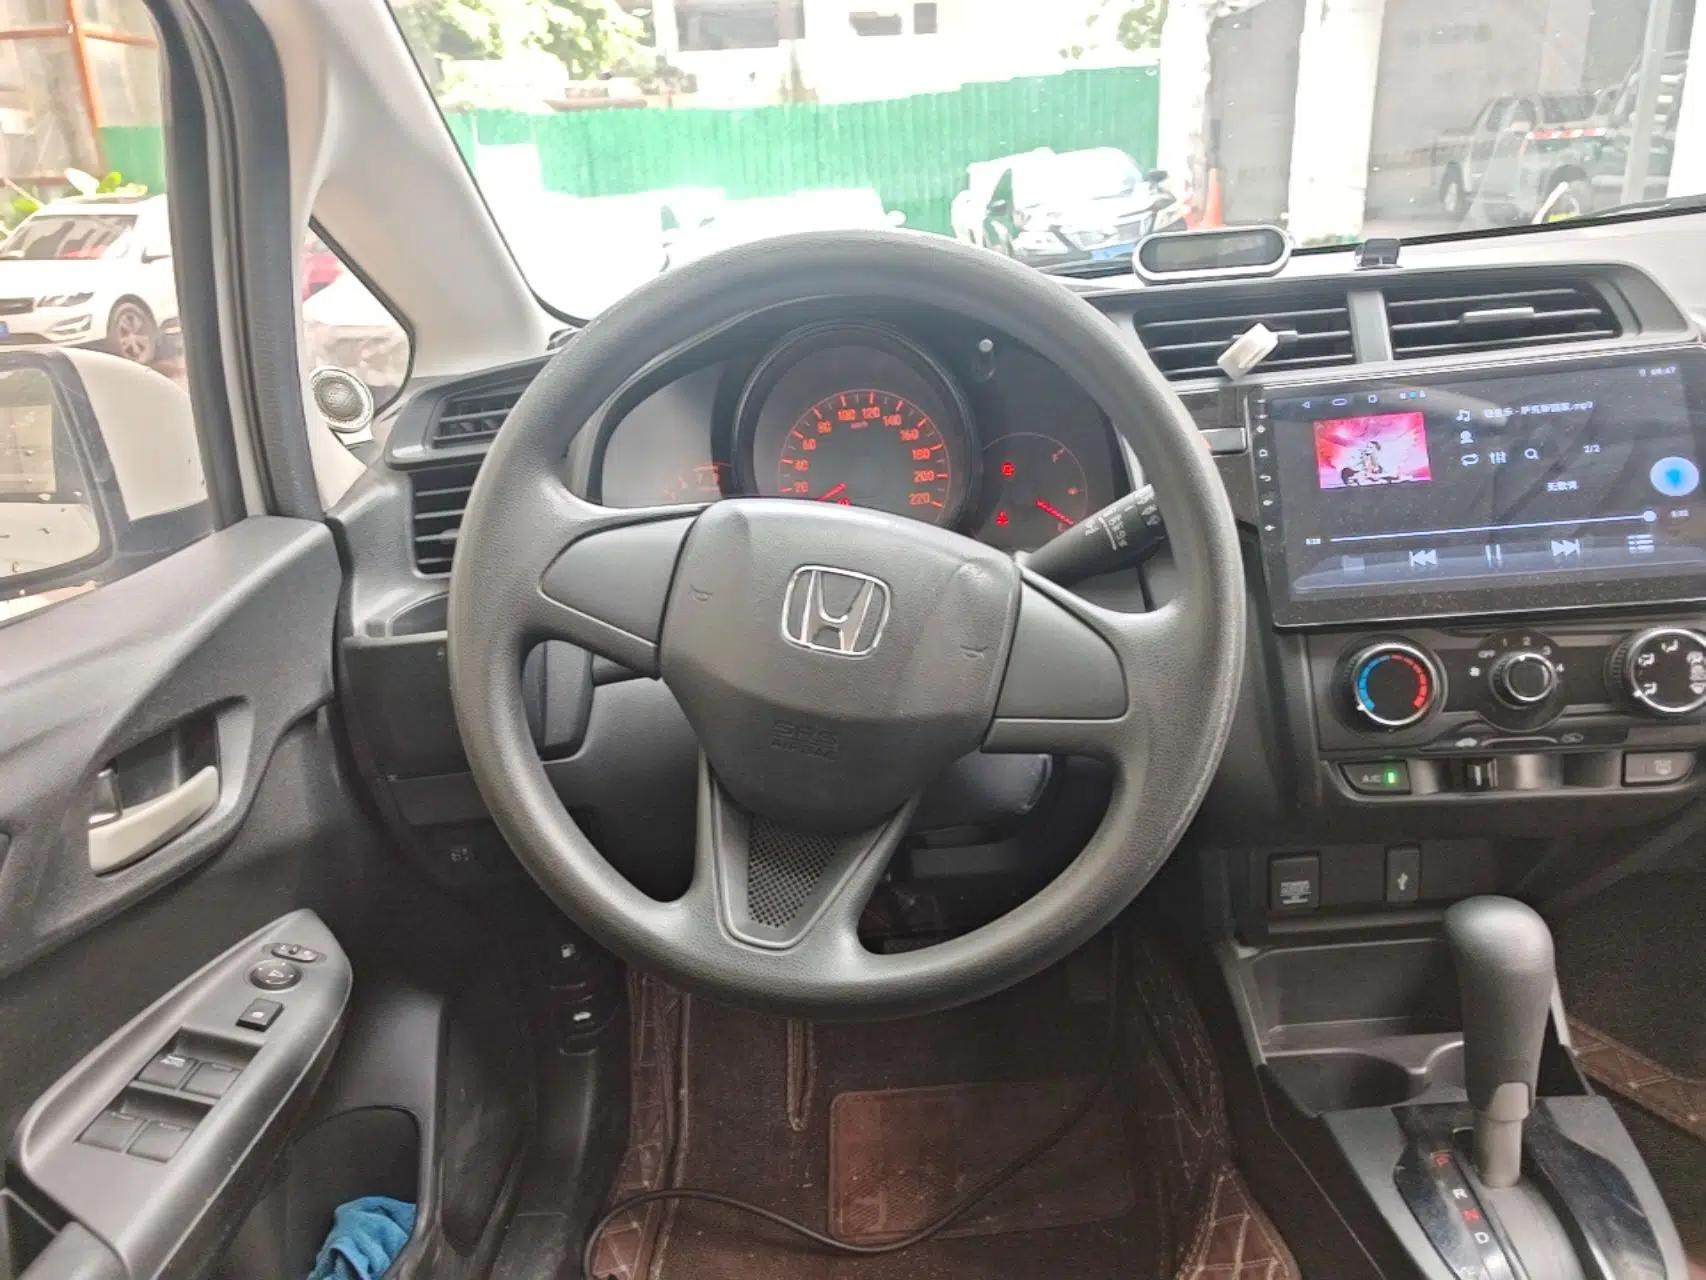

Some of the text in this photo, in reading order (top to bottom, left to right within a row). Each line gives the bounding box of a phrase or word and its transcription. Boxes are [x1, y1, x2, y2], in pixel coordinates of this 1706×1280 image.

[837, 408, 856, 421] 100
[861, 406, 881, 419] 120
[882, 414, 902, 426] 140
[900, 428, 919, 441] 160
[802, 438, 817, 450] 60
[1583, 444, 1601, 453] 1/2
[912, 447, 931, 460] 180
[913, 469, 935, 483] 200
[793, 481, 809, 493] 20
[908, 492, 931, 505] 220
[1502, 638, 1508, 648] 1
[1522, 636, 1531, 646] 2
[1543, 645, 1552, 656] 3
[1555, 663, 1565, 673] 4
[1452, 1188, 1468, 1200] R
[1474, 1231, 1490, 1244] D
